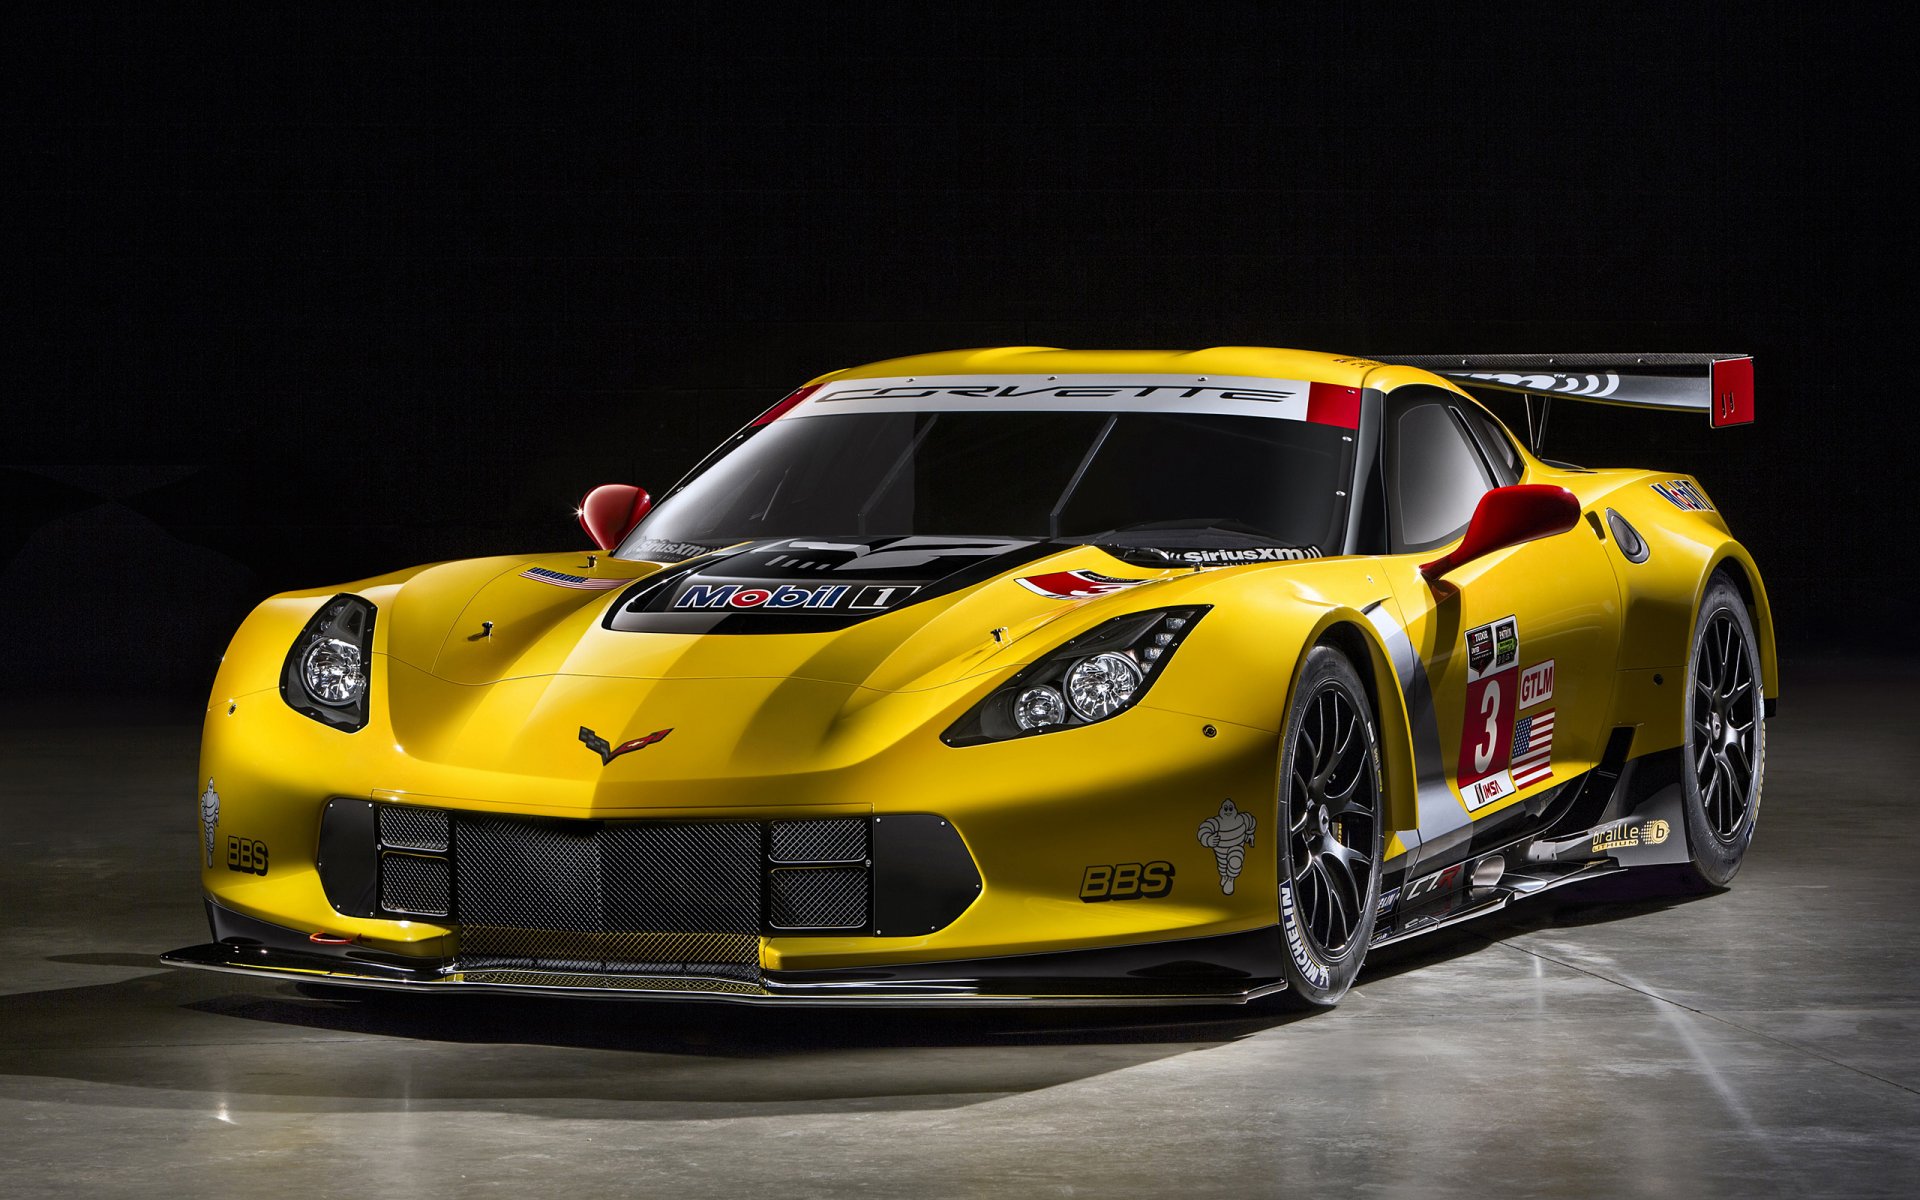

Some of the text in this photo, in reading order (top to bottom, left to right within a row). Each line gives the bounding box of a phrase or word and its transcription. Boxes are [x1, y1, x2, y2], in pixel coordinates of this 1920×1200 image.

[815, 384, 1296, 404] CORVETTE
[1648, 480, 1707, 512] Mobil
[674, 585, 851, 609] Mobil
[1521, 666, 1553, 702] GTLM
[1474, 679, 1502, 774] 3
[1592, 822, 1639, 846] braille
[1592, 839, 1639, 853] LITHIUM
[227, 836, 269, 877] BBS
[1079, 860, 1176, 904] BBS
[1281, 888, 1320, 983] MICHELIN
